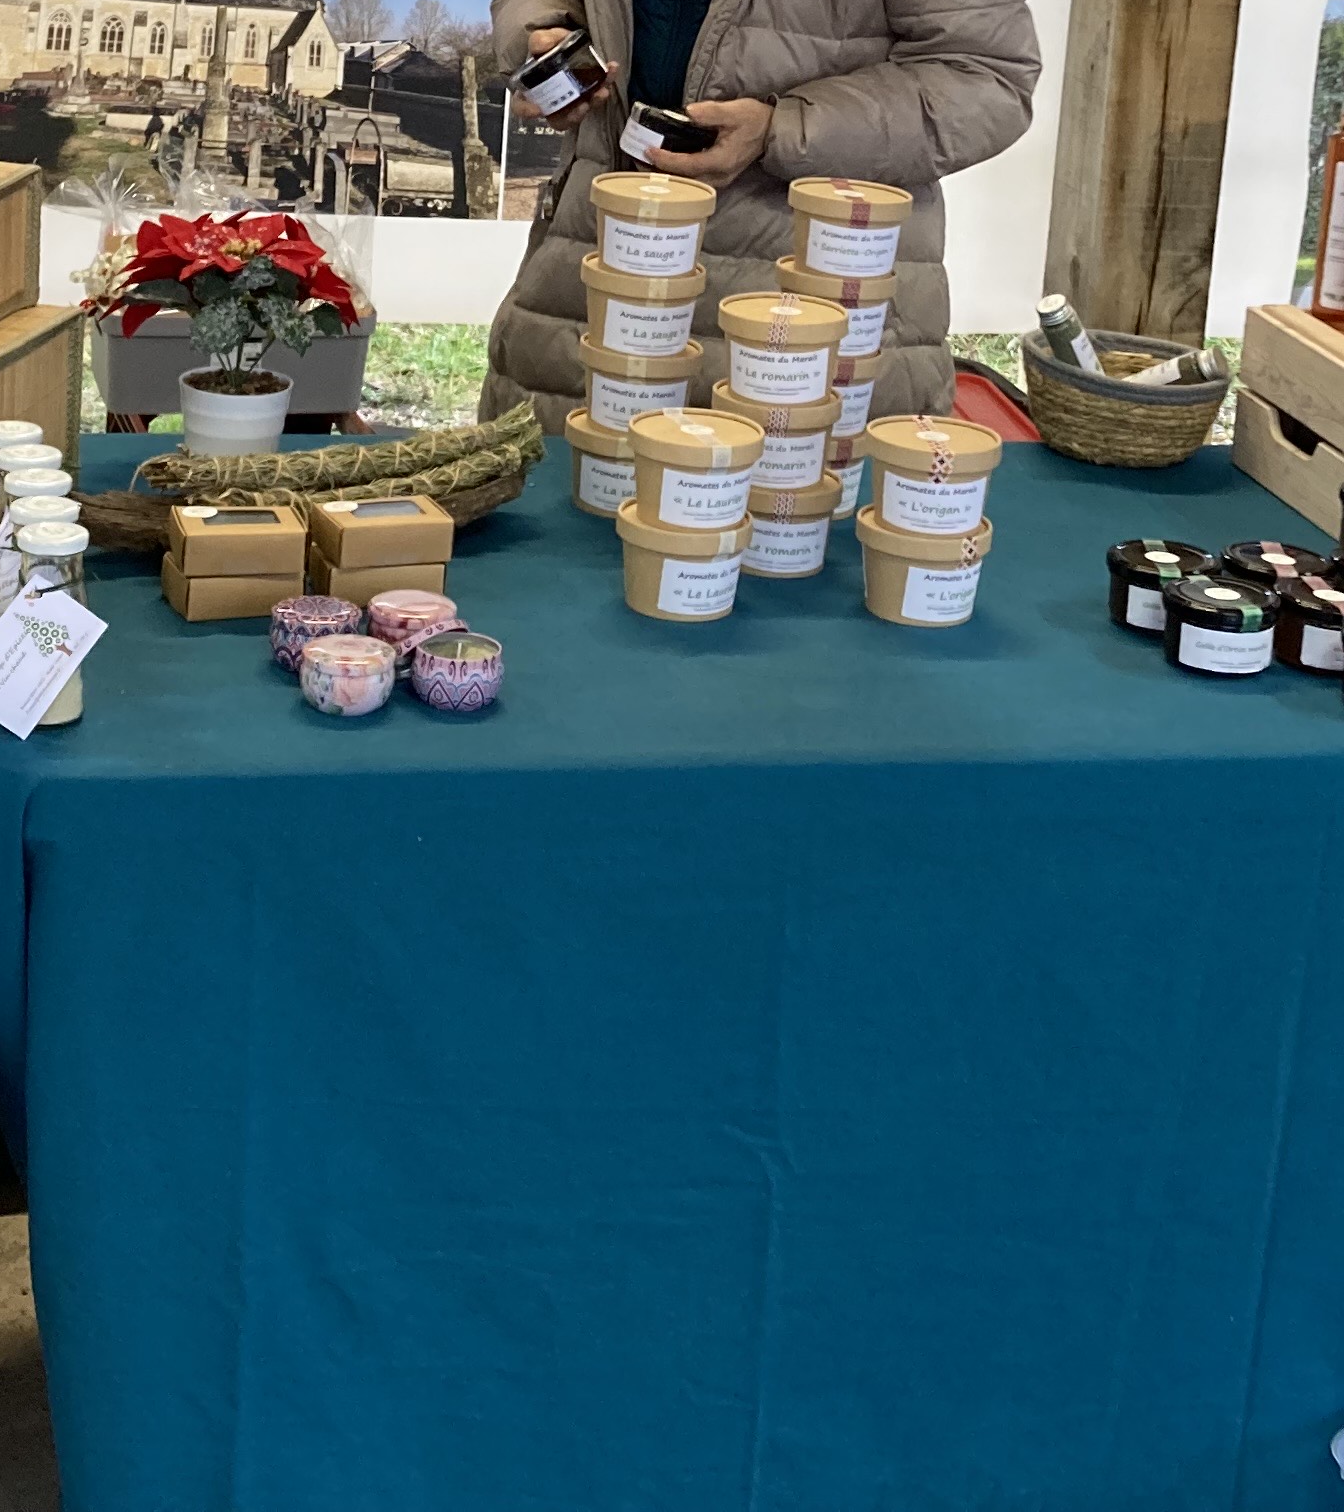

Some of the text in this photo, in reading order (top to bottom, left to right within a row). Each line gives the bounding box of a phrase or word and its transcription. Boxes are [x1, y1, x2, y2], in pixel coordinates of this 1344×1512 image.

[614, 227, 650, 241] Aromates
[626, 246, 640, 256] La
[644, 250, 674, 261] sauge
[620, 311, 658, 322] Aromates
[633, 329, 646, 338] La
[739, 349, 775, 362] Aromates
[778, 355, 789, 363] du
[746, 367, 756, 378] Le
[761, 371, 809, 381] romarin
[613, 403, 626, 413] La
[759, 460, 806, 470] romarin
[678, 479, 720, 489] Aromates
[896, 481, 936, 495] Aromates
[939, 488, 950, 496] du
[687, 496, 702, 508] Le
[912, 502, 960, 517] L'origan
[765, 547, 811, 556] romarin
[688, 589, 702, 599] Le
